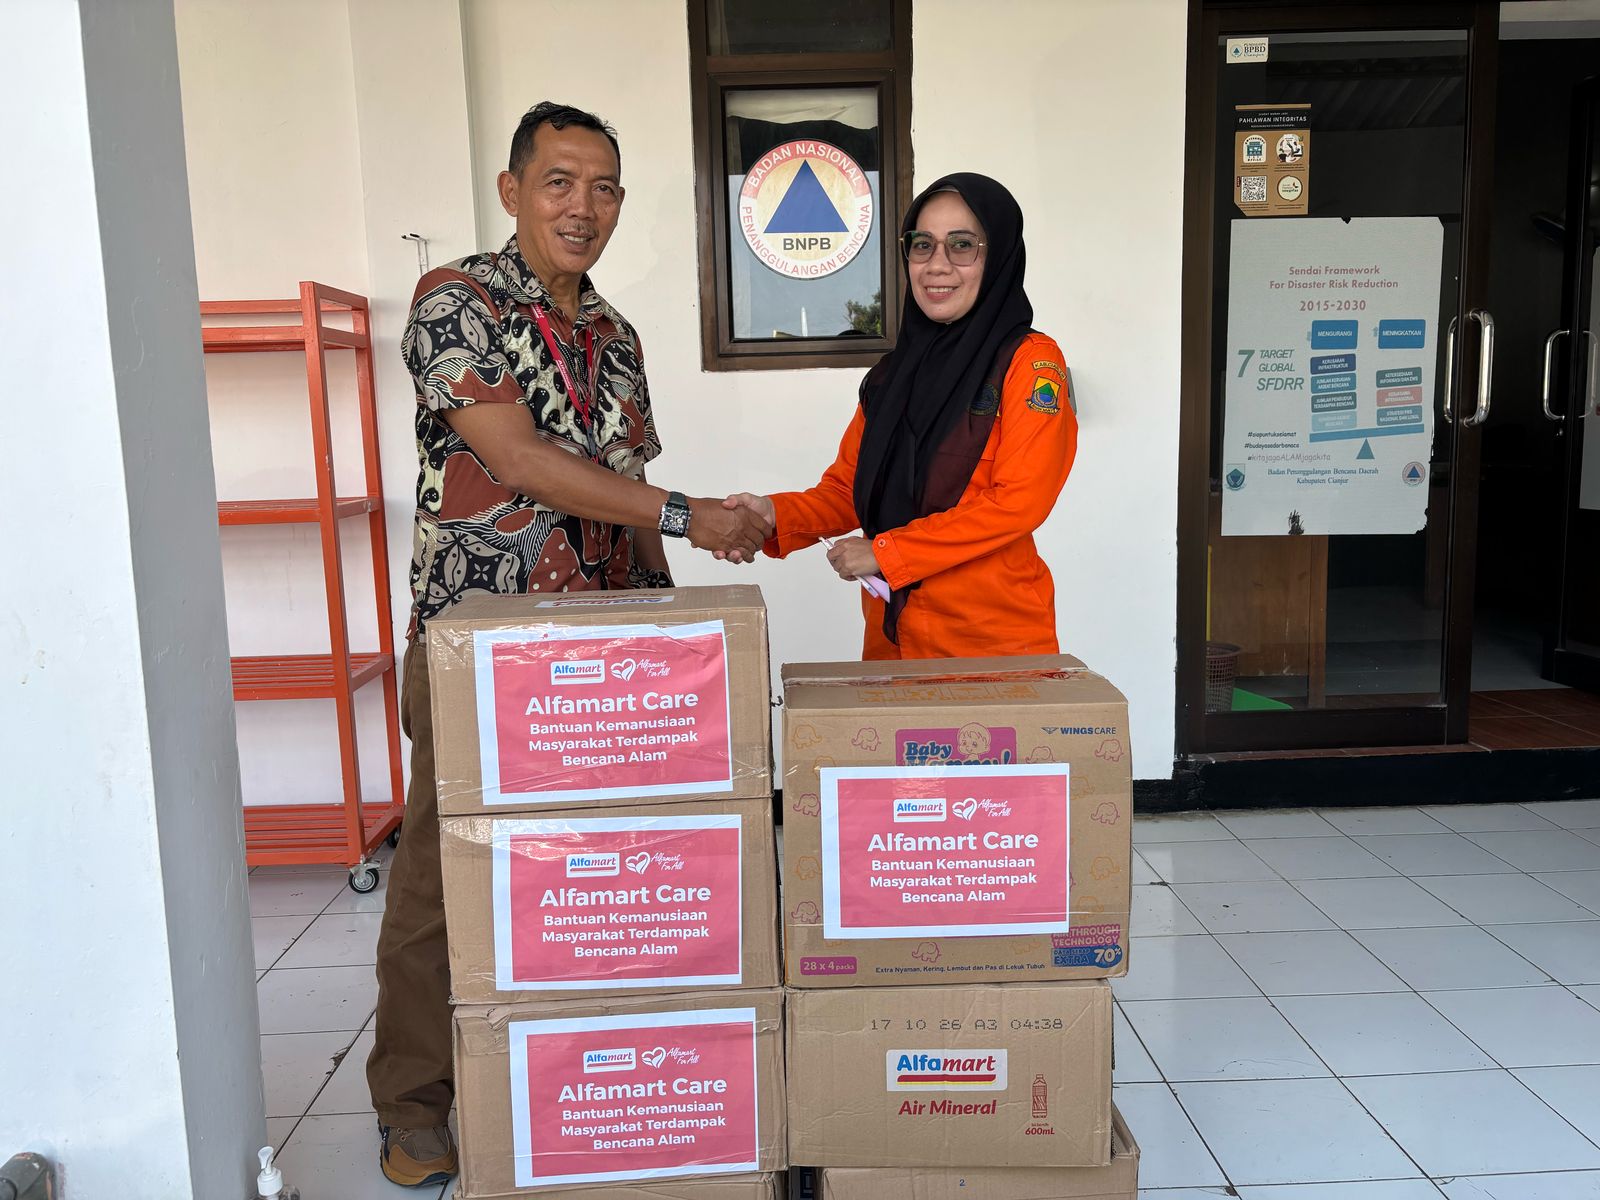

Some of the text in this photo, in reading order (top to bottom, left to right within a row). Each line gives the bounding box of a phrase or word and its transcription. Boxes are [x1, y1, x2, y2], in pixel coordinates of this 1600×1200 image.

[747, 143, 862, 189] BADAN NASIONAL
[742, 203, 870, 276] PENANGGULANGAN BENCANA
[783, 237, 832, 251] BNPB
[1288, 265, 1381, 276] Sendai Framework
[1269, 278, 1399, 289] For Disaster Risk Reduction
[1299, 299, 1367, 311] 2015-2030
[1259, 349, 1295, 359] TARGET
[1237, 349, 1256, 378] 7
[1258, 362, 1296, 372] GLOBAL
[1256, 377, 1305, 391] SFDRR
[1286, 467, 1332, 477] Penanggulangan
[1333, 467, 1357, 475] Bencana
[1358, 467, 1379, 475] Daerah
[1296, 477, 1349, 485] Kabupaten Cianjur
[554, 664, 601, 674] Alfamart
[637, 659, 667, 672] Alfamart
[524, 691, 699, 716] Alfamart Care
[530, 716, 696, 735] Bantuan Kemanusiaan
[529, 730, 698, 754] Masyarakat Terdampak
[904, 741, 952, 760] Baby
[562, 751, 667, 767] Bencana Alam
[897, 802, 943, 812] Alfamart
[977, 799, 1008, 812] Alfamart
[867, 831, 1039, 852] Alfamart Care
[569, 857, 616, 867] Alfamart
[651, 852, 681, 865] Alfamart
[871, 856, 1035, 871] Bantuan Kemanusiaan
[870, 872, 1037, 890] Masyarakat Terdampak
[539, 884, 711, 908] Alfamart Care
[902, 890, 1006, 903] Bencana Alam
[544, 909, 707, 926] Bantuan Kemanusiaan
[542, 925, 709, 945] Masyarakat Terdampak
[1070, 925, 1119, 937] THROUGH
[1053, 935, 1119, 947] TECHNOLOGY
[574, 943, 678, 958] Bencana Alam
[1054, 947, 1121, 966] EXTRA 70%
[803, 961, 817, 971] 28
[828, 961, 835, 970] 4
[835, 964, 855, 972] packs
[895, 966, 922, 974] Nyaman,
[923, 966, 946, 974] Kering,
[871, 1018, 1063, 1031] 17 10 26 A3 04:38
[587, 1052, 633, 1063] Alfamart
[667, 1047, 696, 1060] Alfamart
[896, 1054, 997, 1072] Alfamart
[558, 1077, 728, 1103] Alfamart Care
[562, 1101, 724, 1121] Bantuan Kemanusiaan
[898, 1099, 997, 1115] Air Mineral
[561, 1115, 726, 1138] Masyarakat Terdampak
[1024, 1127, 1056, 1136] 600mL
[593, 1133, 695, 1150] Bencana Alam
[959, 1178, 966, 1187] 2
